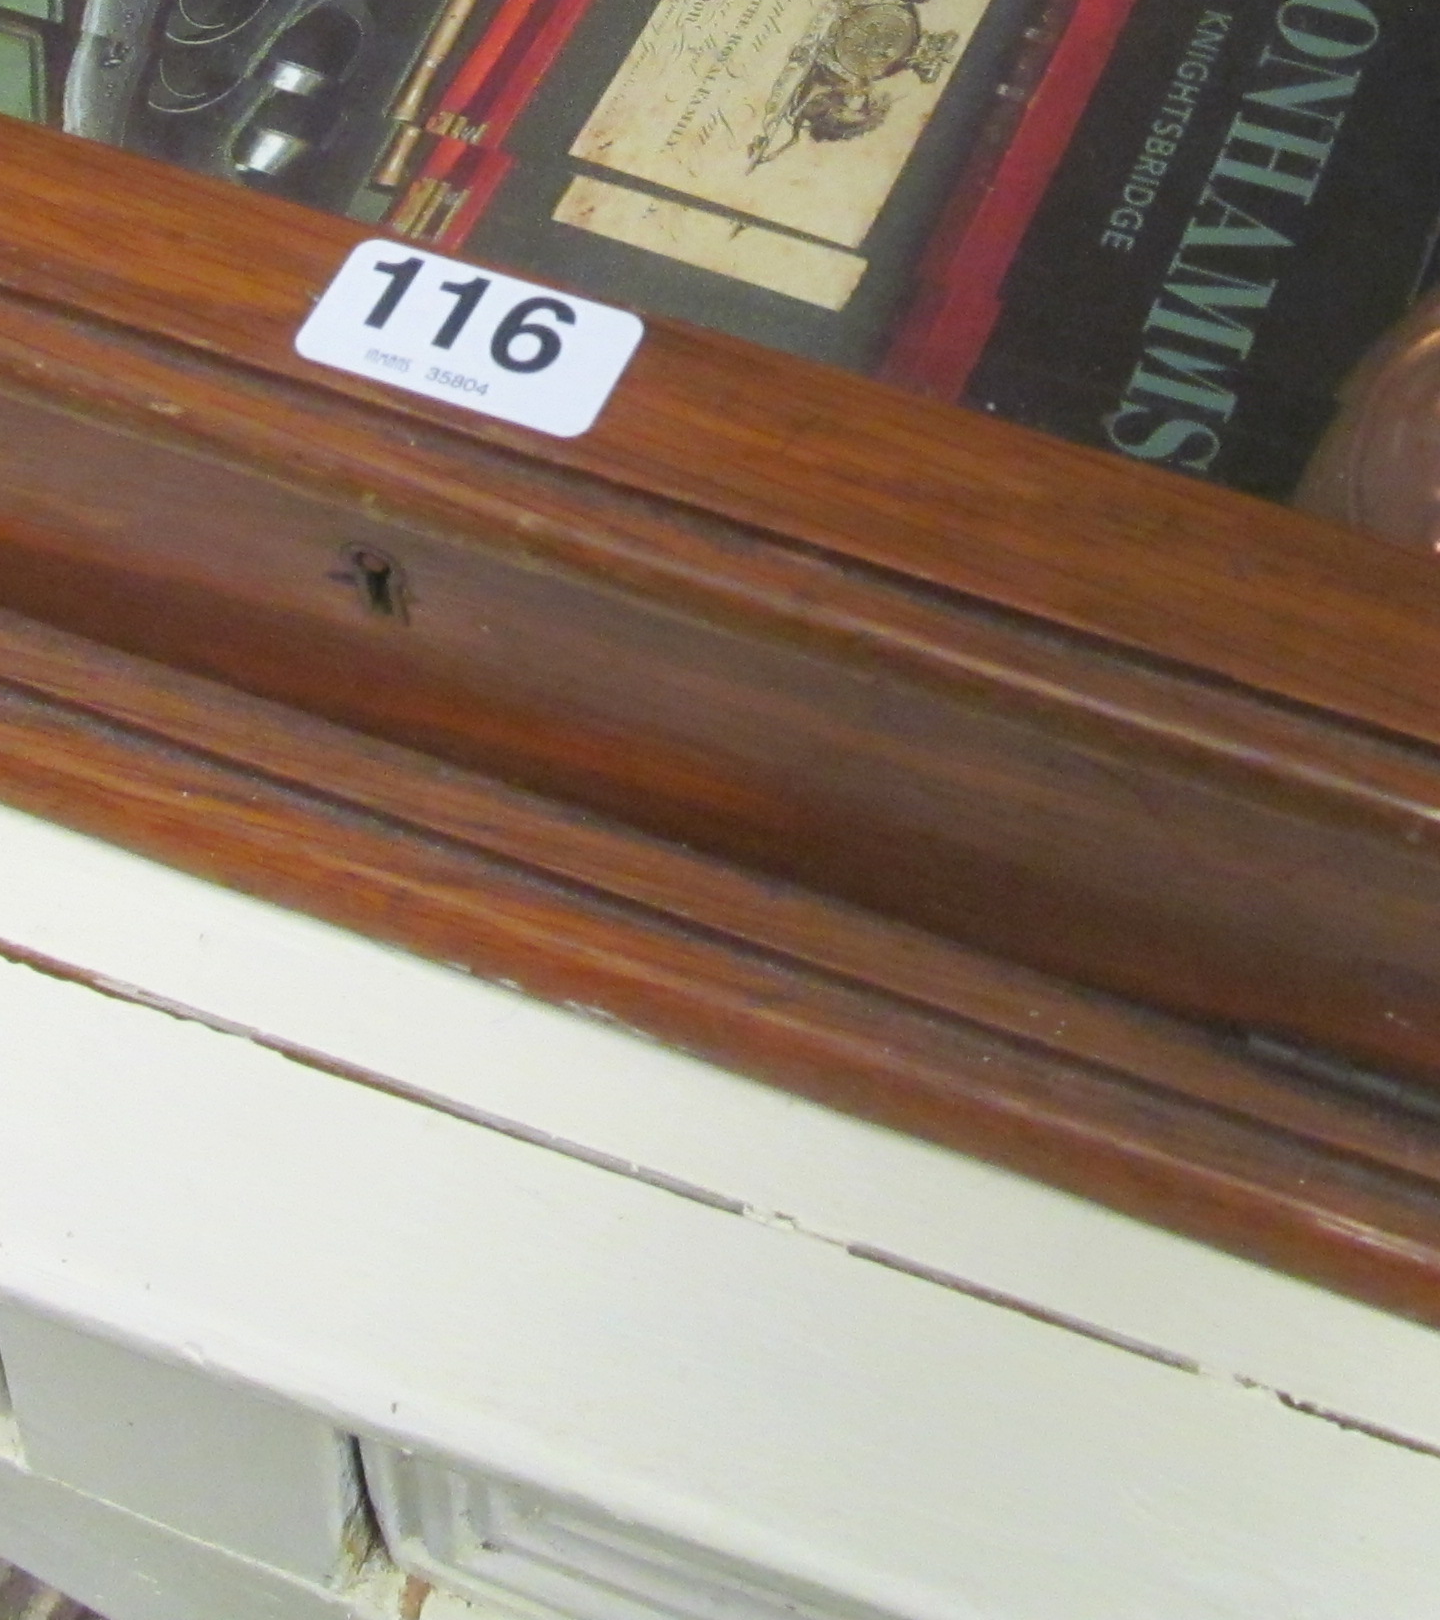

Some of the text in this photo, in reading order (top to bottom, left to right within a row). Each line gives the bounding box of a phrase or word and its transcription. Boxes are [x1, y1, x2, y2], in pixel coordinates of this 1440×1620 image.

[1101, 9, 1234, 252] KNIGHTSBRIDGE
[364, 257, 577, 373] 116
[425, 367, 490, 396] 35804
